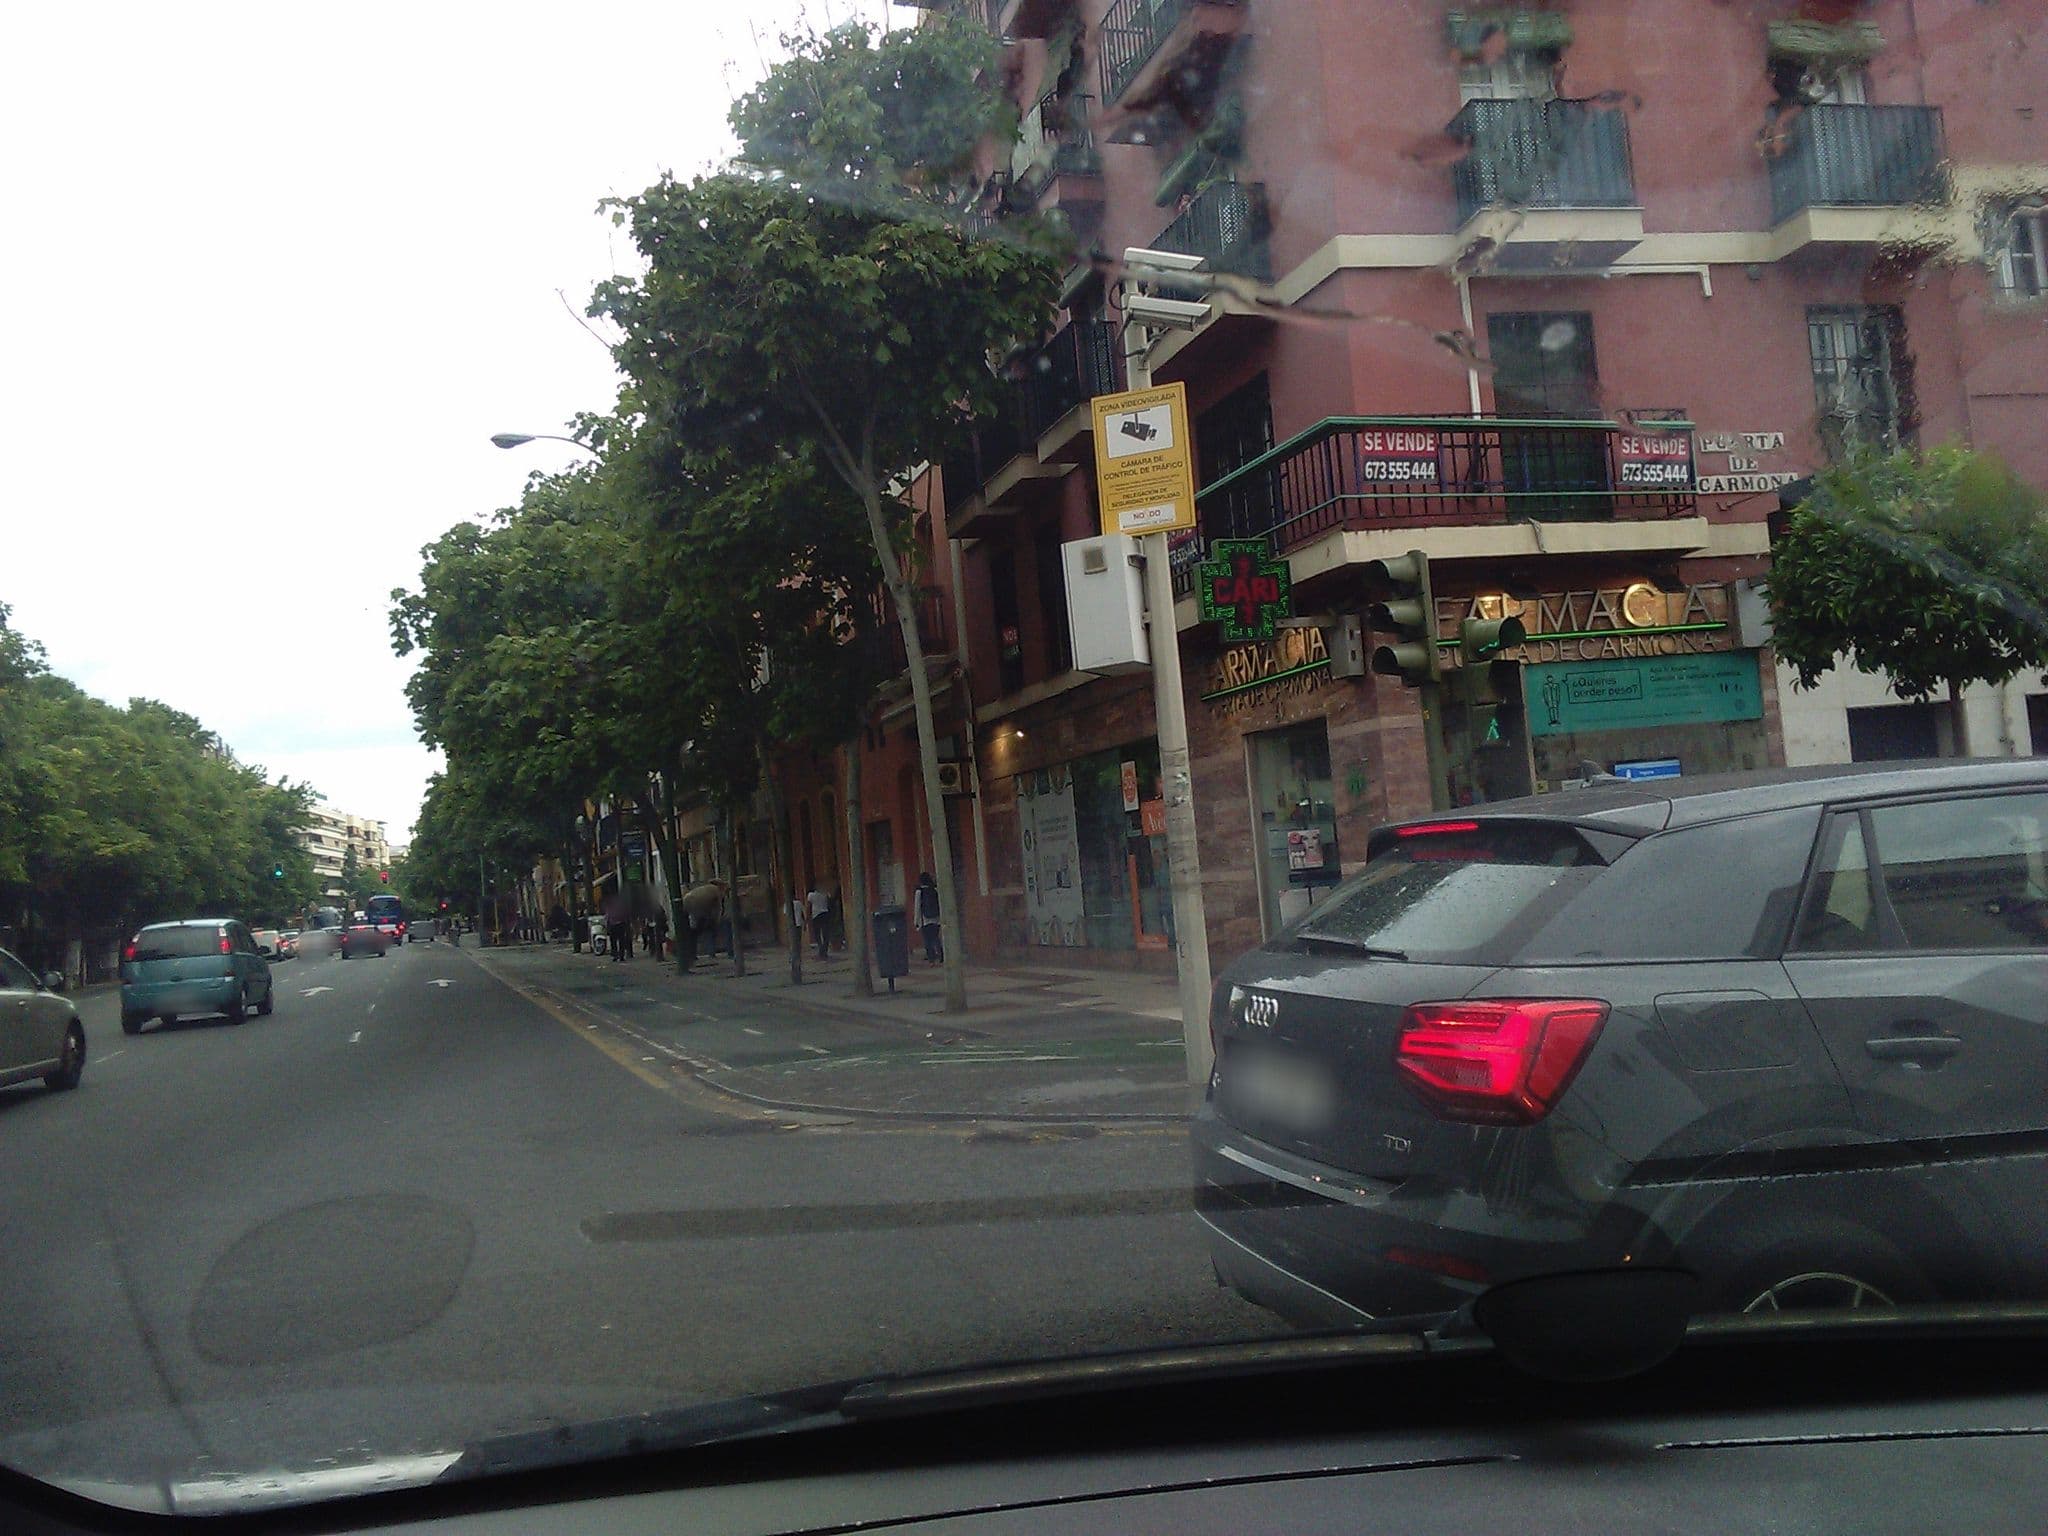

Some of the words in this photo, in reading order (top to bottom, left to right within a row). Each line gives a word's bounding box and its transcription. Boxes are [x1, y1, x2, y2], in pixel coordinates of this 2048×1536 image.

[1099, 404, 1120, 413] ZONA
[1364, 432, 1383, 451] SE
[1385, 432, 1435, 451] VENDE
[1622, 436, 1640, 455] SE
[1642, 437, 1687, 456] VENDE
[1153, 455, 1165, 463] DE
[1731, 456, 1757, 471] DE
[1104, 469, 1139, 480] CONTROL
[1140, 467, 1150, 475] DE
[1384, 1134, 1412, 1152] TDI
